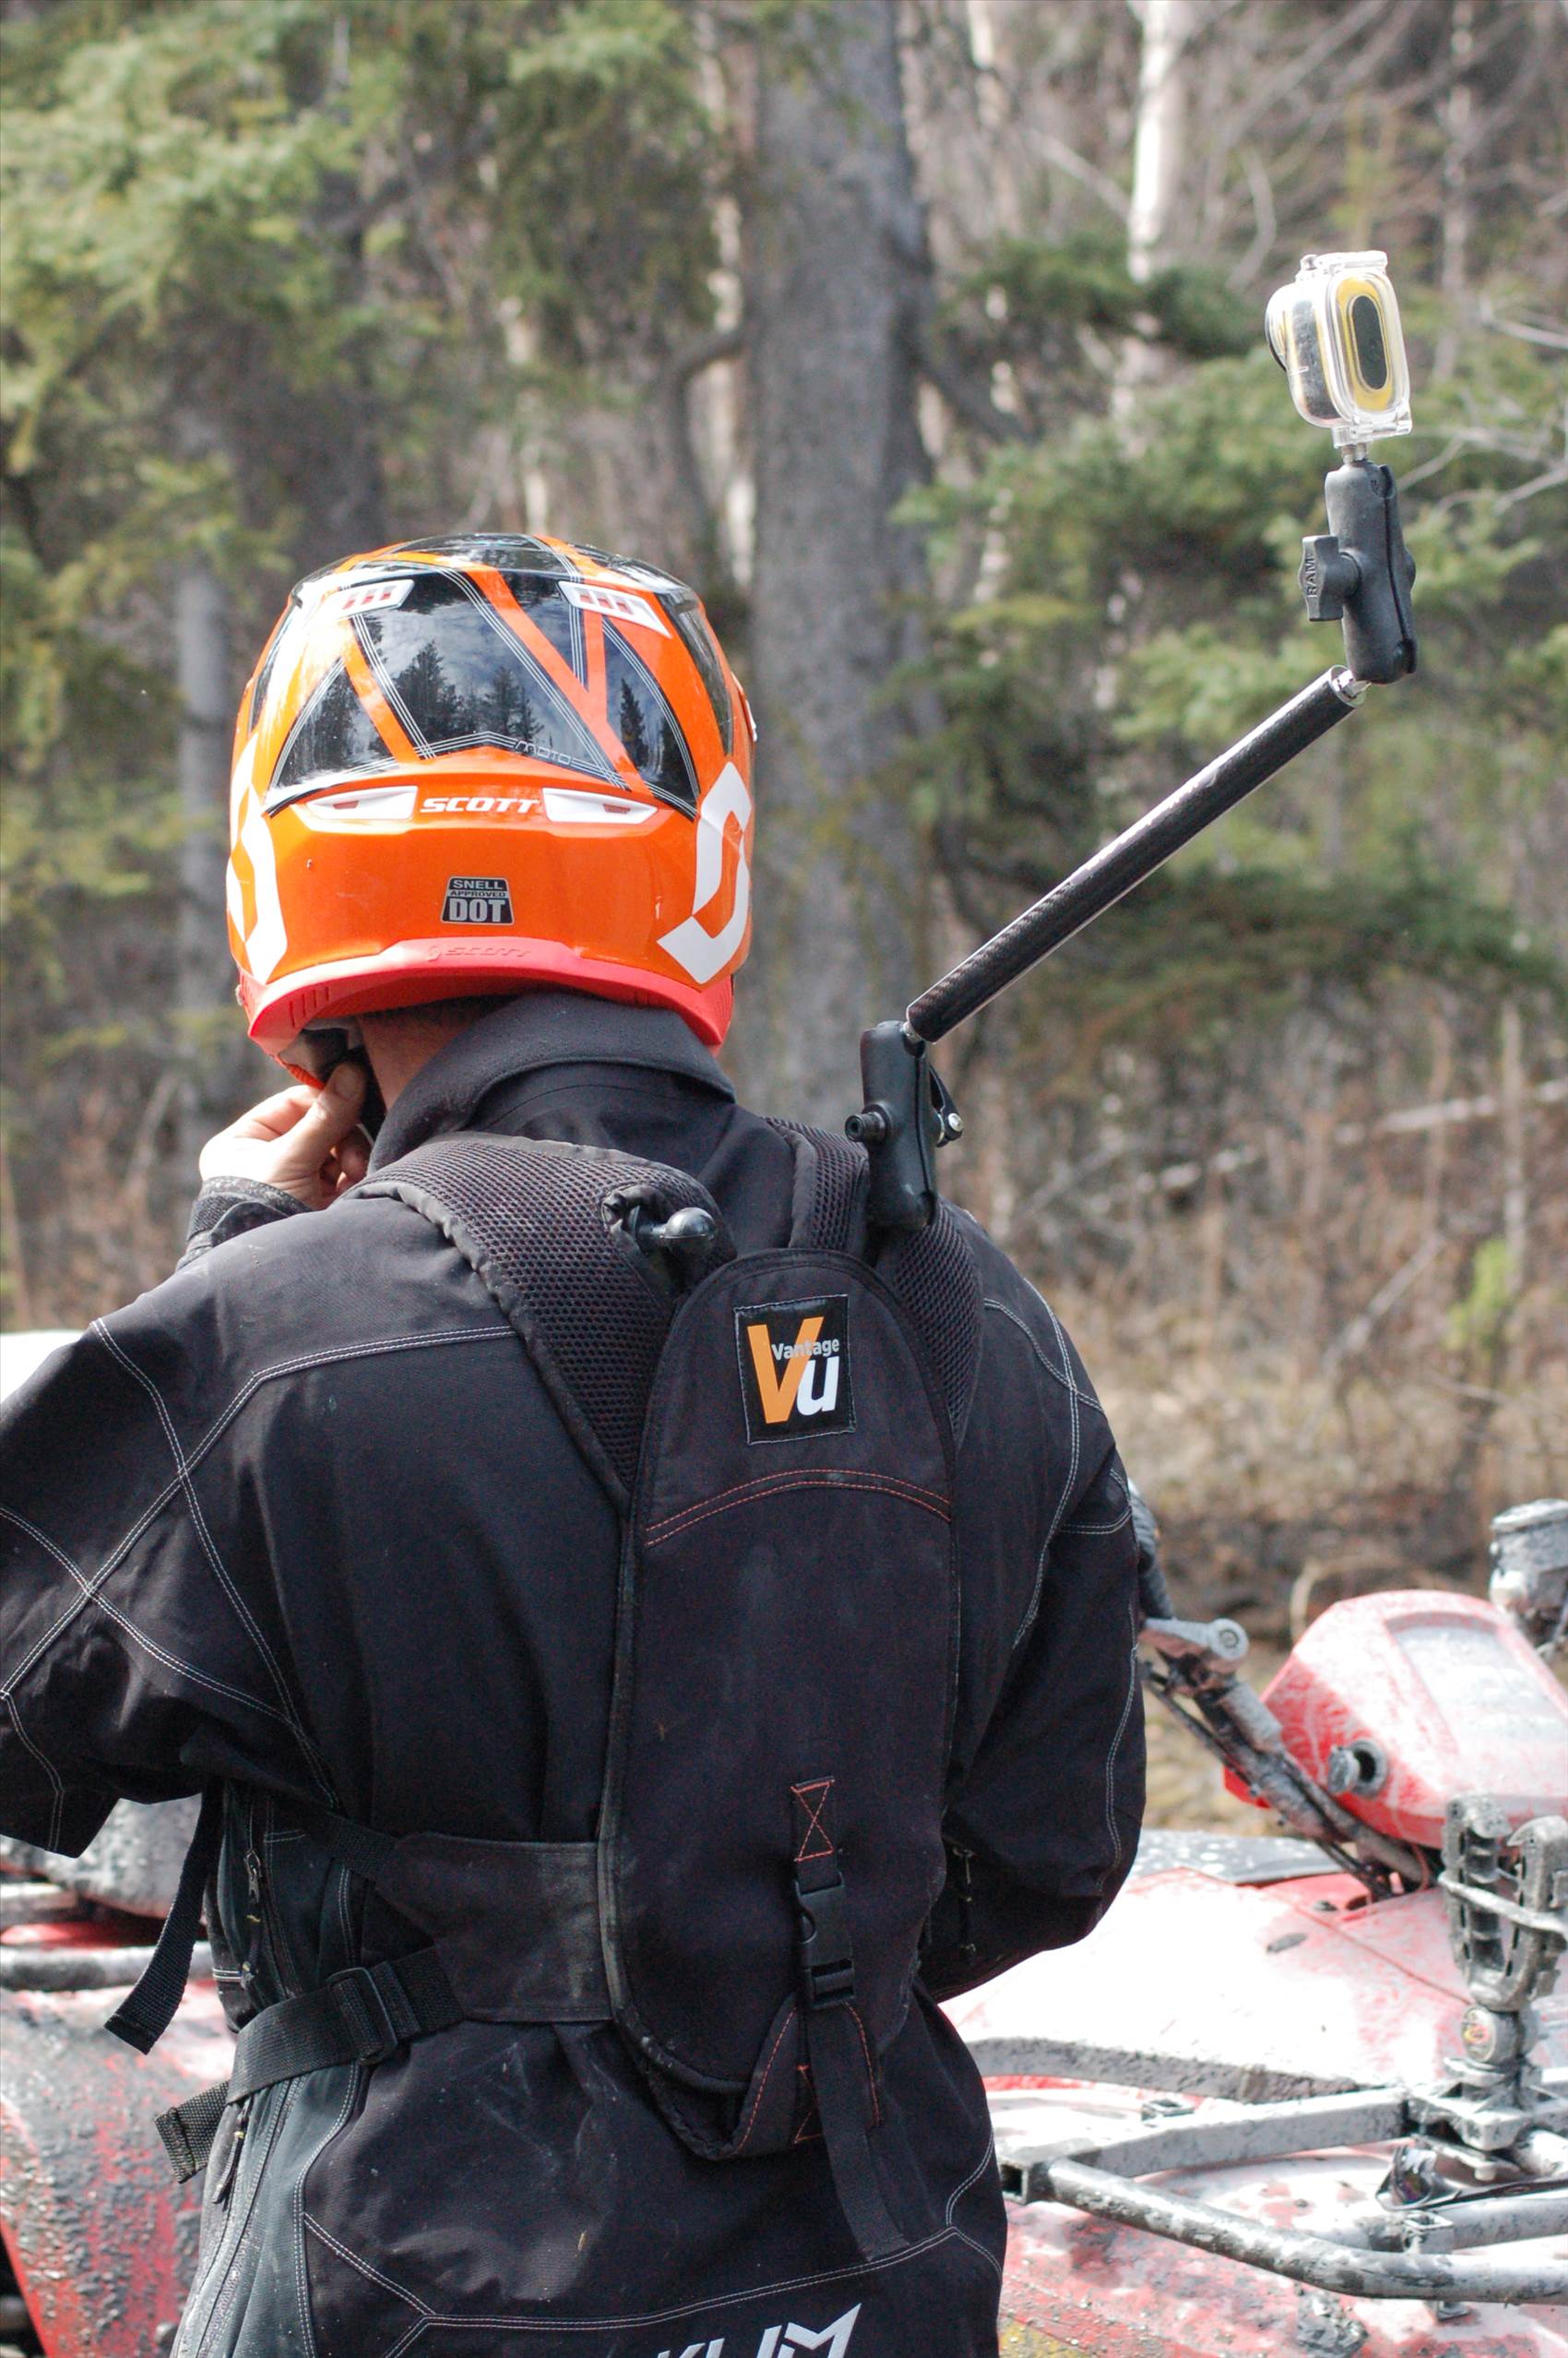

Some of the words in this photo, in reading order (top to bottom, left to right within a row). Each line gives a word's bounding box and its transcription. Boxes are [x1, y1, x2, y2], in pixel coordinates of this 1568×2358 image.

[1305, 557, 1318, 598] RAM
[516, 741, 571, 766] MOTO
[420, 797, 540, 814] SCOTT
[453, 879, 504, 890] SNELL
[448, 898, 506, 923] DOT
[771, 1338, 840, 1361] Vantage
[656, 2303, 861, 2358] IM
